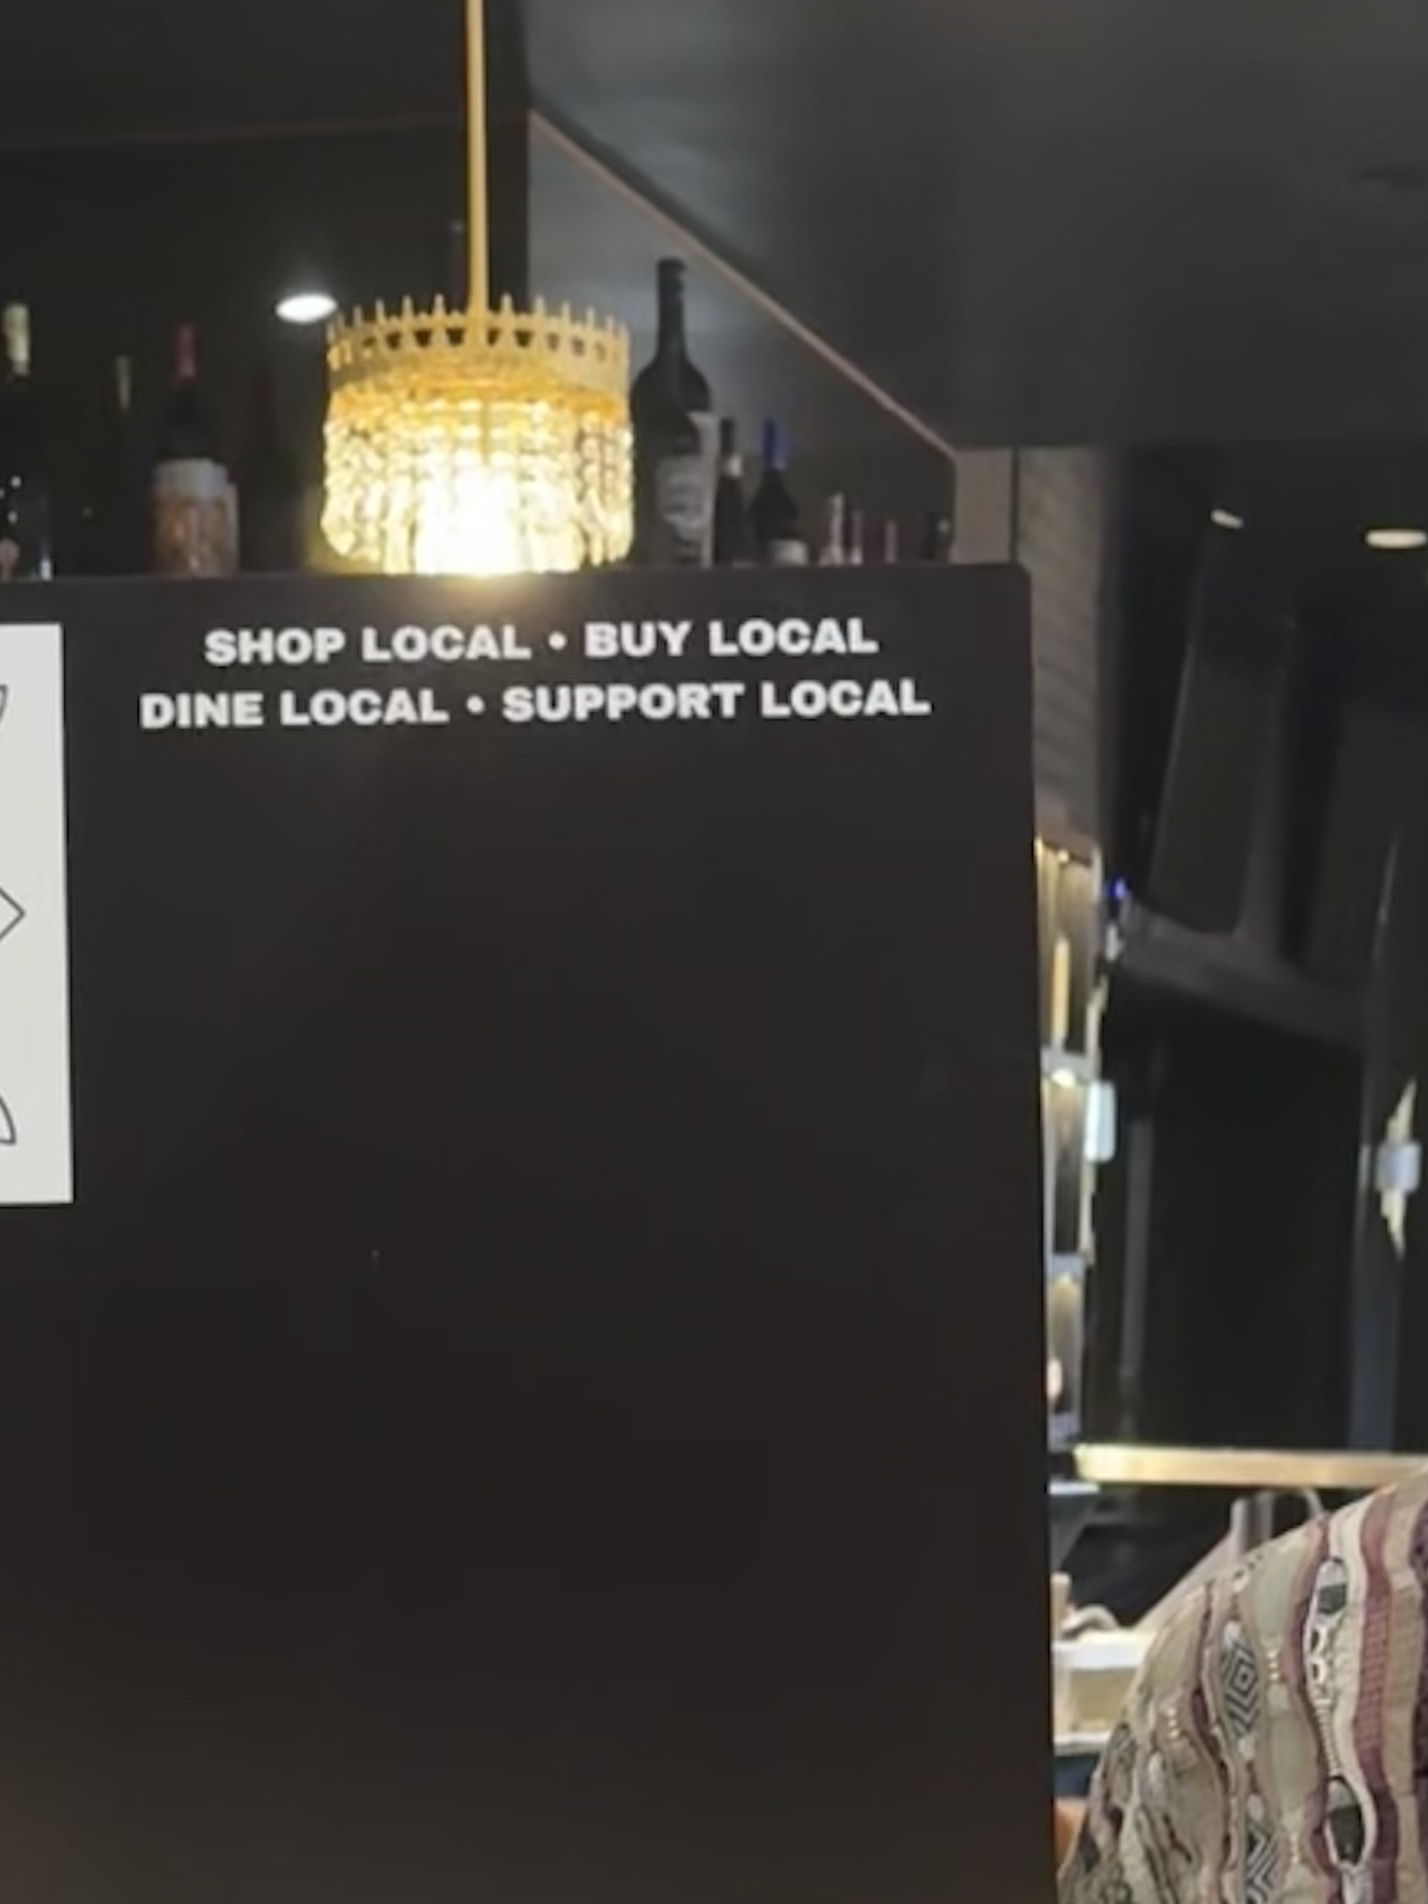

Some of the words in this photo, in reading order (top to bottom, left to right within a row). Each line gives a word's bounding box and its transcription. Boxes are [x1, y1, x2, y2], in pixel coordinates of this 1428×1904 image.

[205, 627, 346, 666] SHOP
[362, 624, 532, 663] LOCAL
[584, 620, 693, 658] BUY
[708, 617, 880, 656] LOCAL
[139, 692, 265, 729] DINE
[279, 688, 450, 727] LOCAL
[502, 681, 746, 723] SUPPORT
[760, 678, 932, 718] LOCAL
